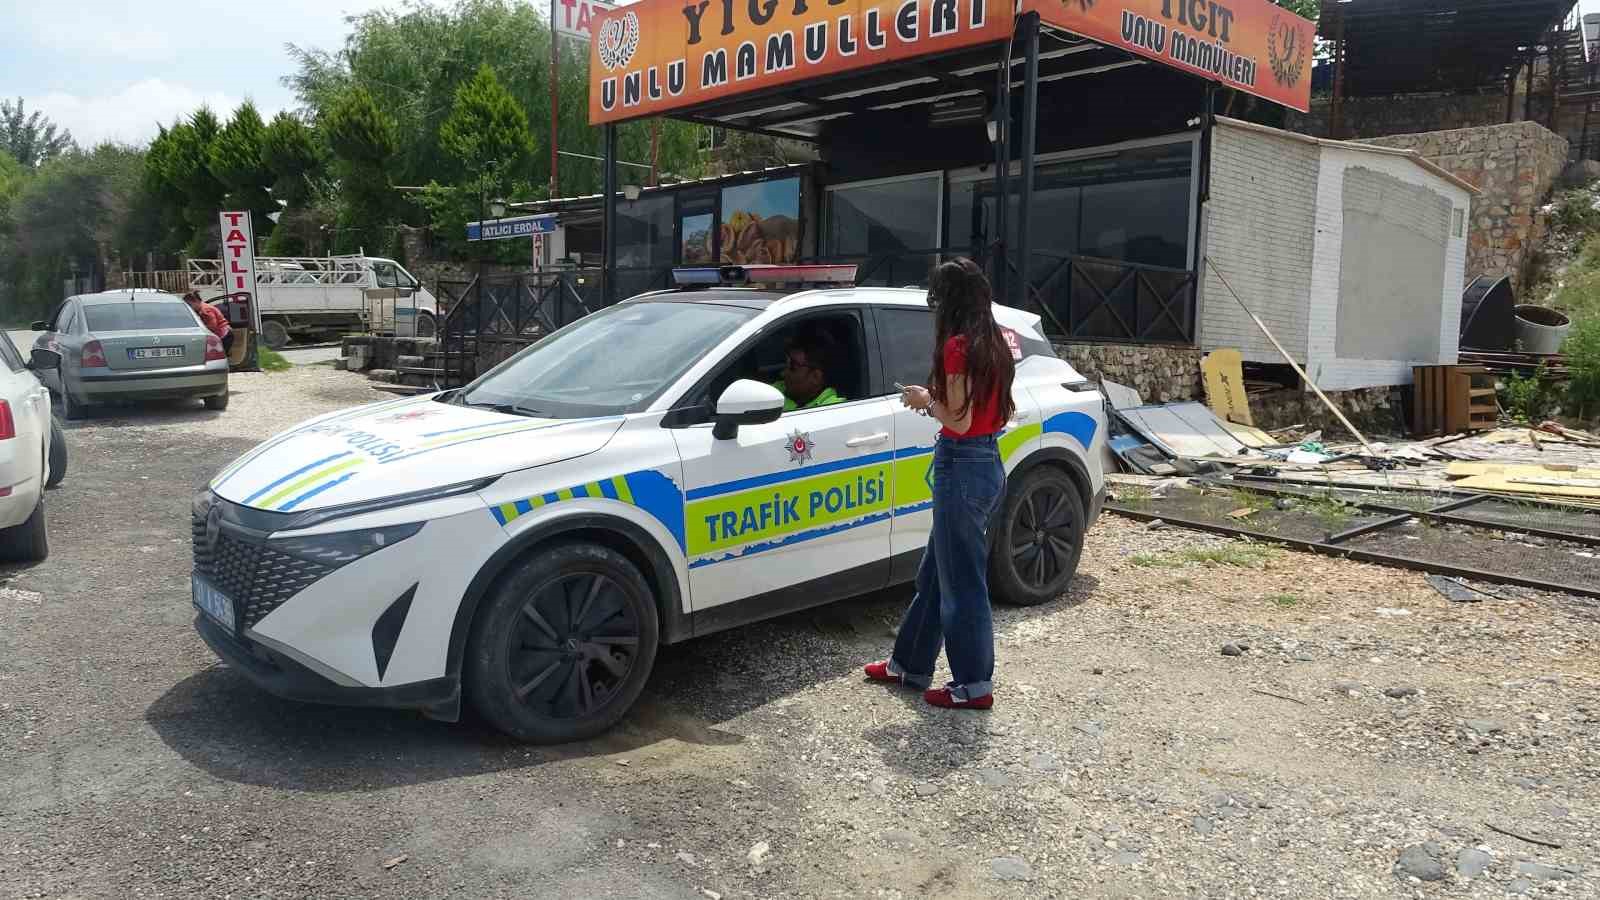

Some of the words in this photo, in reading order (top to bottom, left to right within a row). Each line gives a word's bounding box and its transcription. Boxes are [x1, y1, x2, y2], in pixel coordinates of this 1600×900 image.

[514, 220, 544, 233] ERDAL
[705, 493, 800, 542] TRAFİK
[809, 471, 884, 518] POLİSİ
